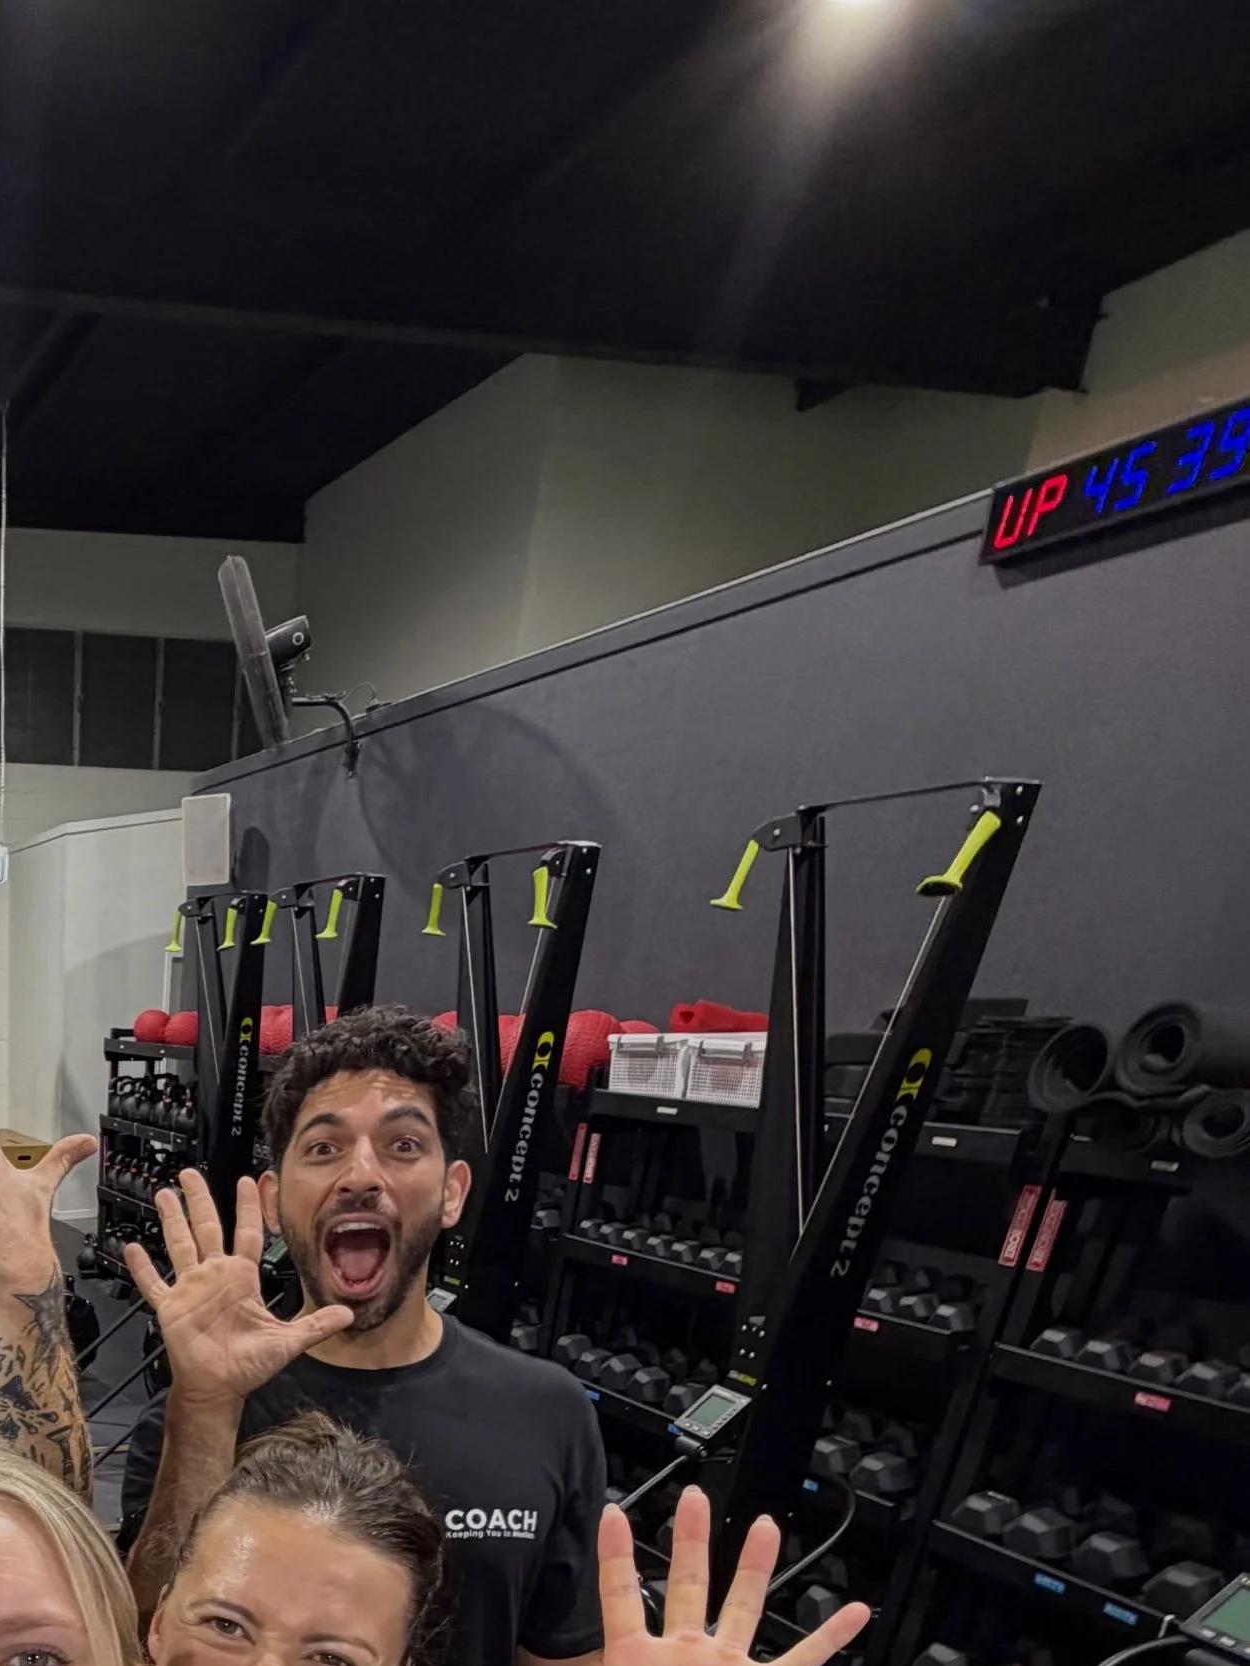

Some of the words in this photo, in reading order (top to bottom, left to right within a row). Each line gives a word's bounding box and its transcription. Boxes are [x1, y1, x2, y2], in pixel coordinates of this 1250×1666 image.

[993, 474, 1068, 549] UP
[1083, 441, 1157, 514] 45
[1166, 404, 1250, 496] 39
[232, 1045, 249, 1122] concept
[231, 1126, 242, 1136] 2
[509, 1072, 543, 1183] concept
[839, 1105, 908, 1256] concept
[504, 1188, 520, 1202] 2
[830, 1259, 850, 1278] 2
[445, 1508, 538, 1532] COACH
[445, 1530, 484, 1539] Keeping
[486, 1529, 502, 1537] You
